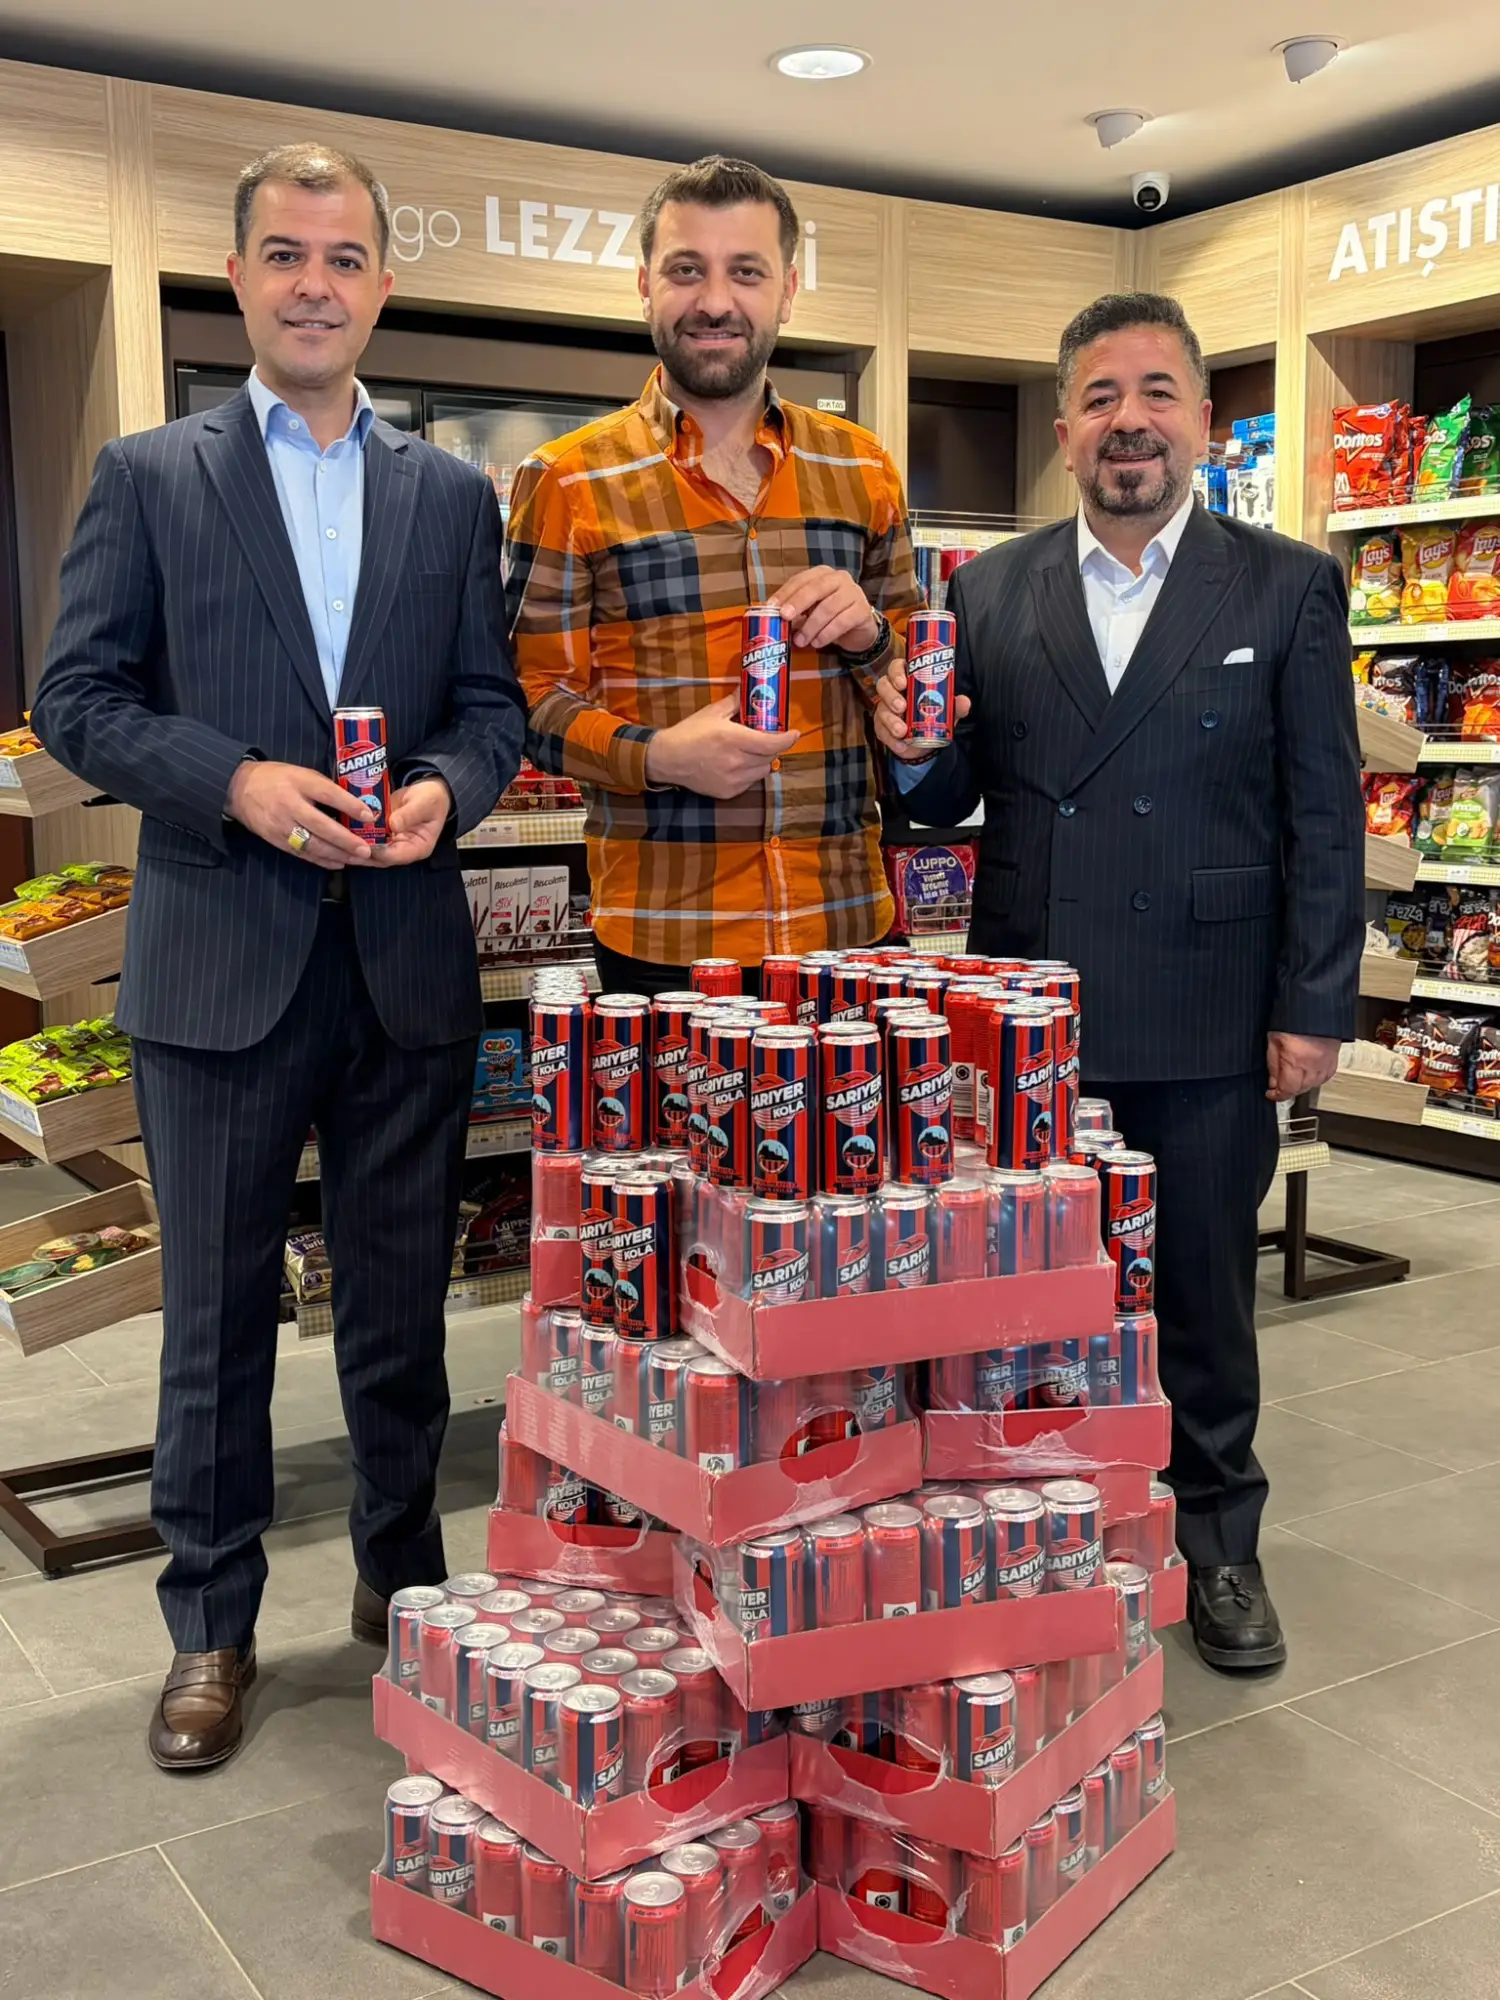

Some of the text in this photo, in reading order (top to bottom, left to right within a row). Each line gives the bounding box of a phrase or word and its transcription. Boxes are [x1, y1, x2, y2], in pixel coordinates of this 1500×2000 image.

[1333, 433, 1383, 449] Doritos
[1419, 541, 1449, 565] Lay's
[742, 642, 787, 667] SARIYER
[764, 655, 787, 670] KOLA
[908, 647, 955, 673] SARIYER
[933, 662, 954, 675] KOLA
[338, 747, 386, 774] SARIYER
[368, 763, 388, 777] KOLA
[912, 856, 957, 870] LUPPO
[1422, 1035, 1461, 1056] Doritos
[539, 1061, 567, 1076] KOLA
[610, 1062, 639, 1080] KOLA
[715, 1090, 744, 1106] KOLA
[772, 1101, 805, 1120] KOLA
[624, 1245, 653, 1261] KOLA
[557, 1496, 585, 1512] KOLA
[444, 1880, 475, 1898] KOLA
